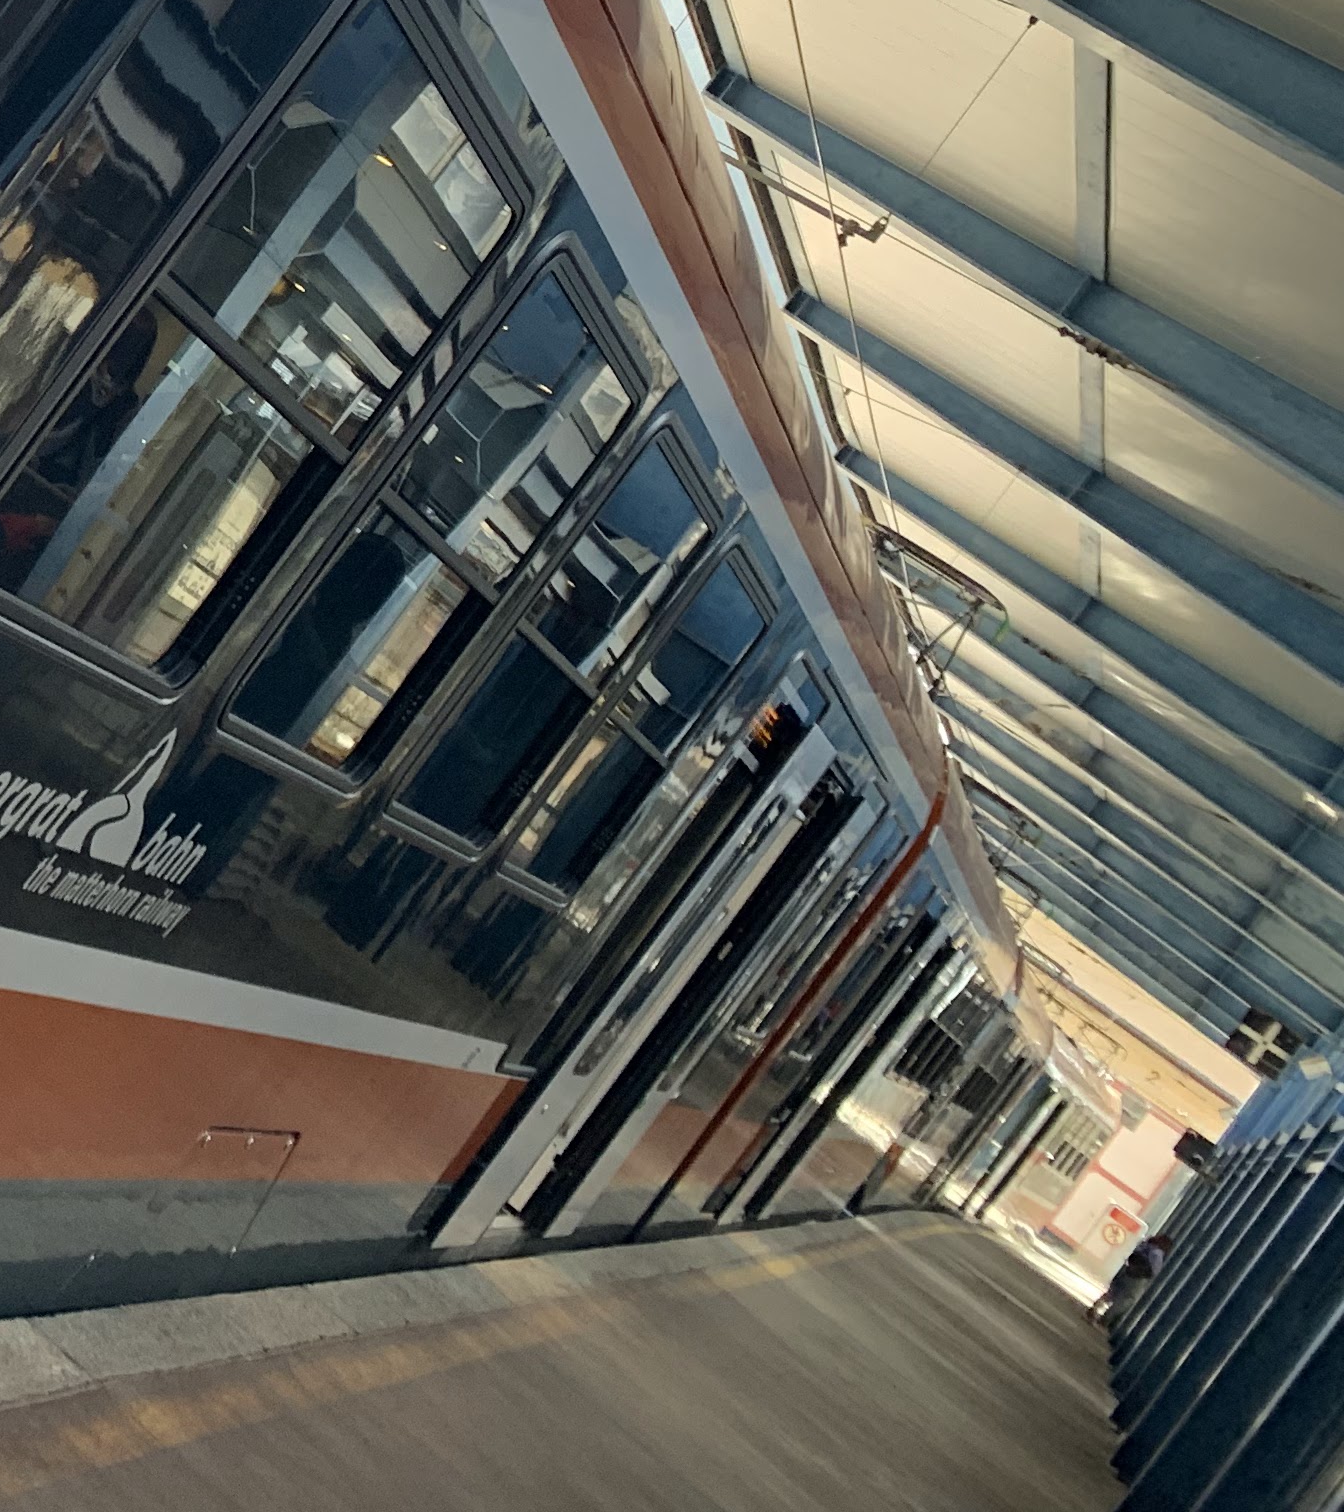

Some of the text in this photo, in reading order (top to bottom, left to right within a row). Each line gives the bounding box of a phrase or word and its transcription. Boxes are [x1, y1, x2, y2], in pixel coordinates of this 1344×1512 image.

[131, 812, 207, 885] bahn
[22, 853, 191, 938] the matterhorn railway
